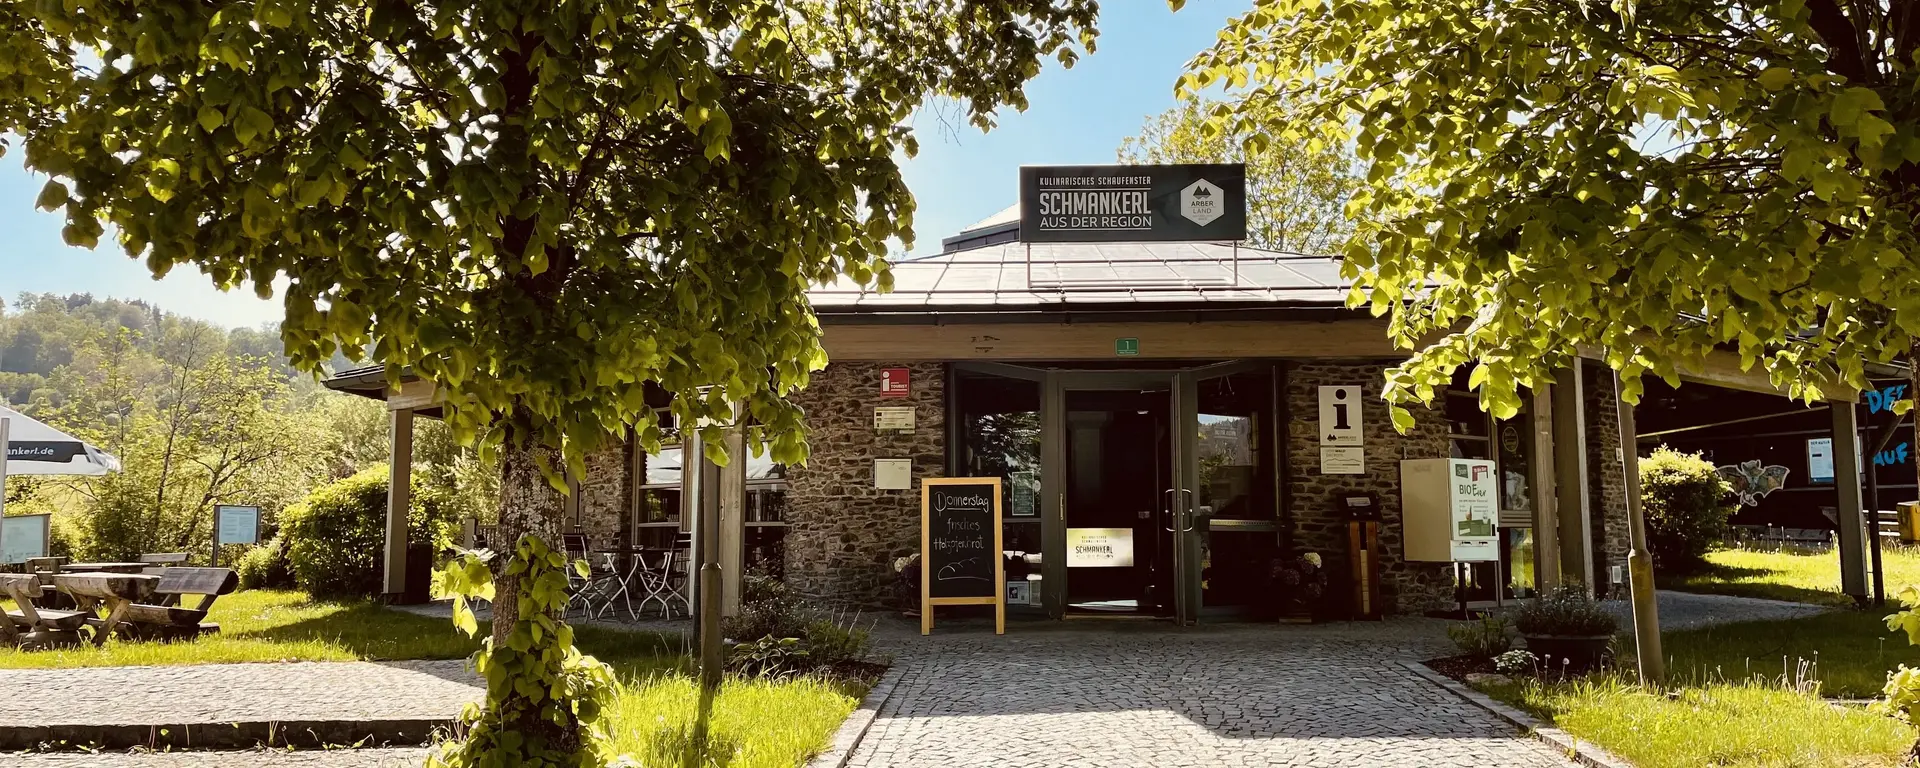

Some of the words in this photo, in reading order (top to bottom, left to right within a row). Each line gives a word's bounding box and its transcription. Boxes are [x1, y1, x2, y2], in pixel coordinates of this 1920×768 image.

[1039, 176, 1095, 186] KULINARISCHES
[1098, 175, 1151, 185] SCHAUFENSTER
[1039, 192, 1152, 215] SCHMANKERL
[1039, 216, 1068, 228] AUS
[1071, 216, 1098, 228] DER
[1101, 215, 1152, 228] REGION
[1125, 340, 1130, 350] 1
[7, 446, 55, 456] ankerl.de
[1873, 442, 1908, 467] AUF
[1459, 484, 1471, 495] BIO
[933, 491, 989, 517] Donnerstag
[946, 516, 981, 535] frisches
[1075, 545, 1113, 554] SCHMANKERL
